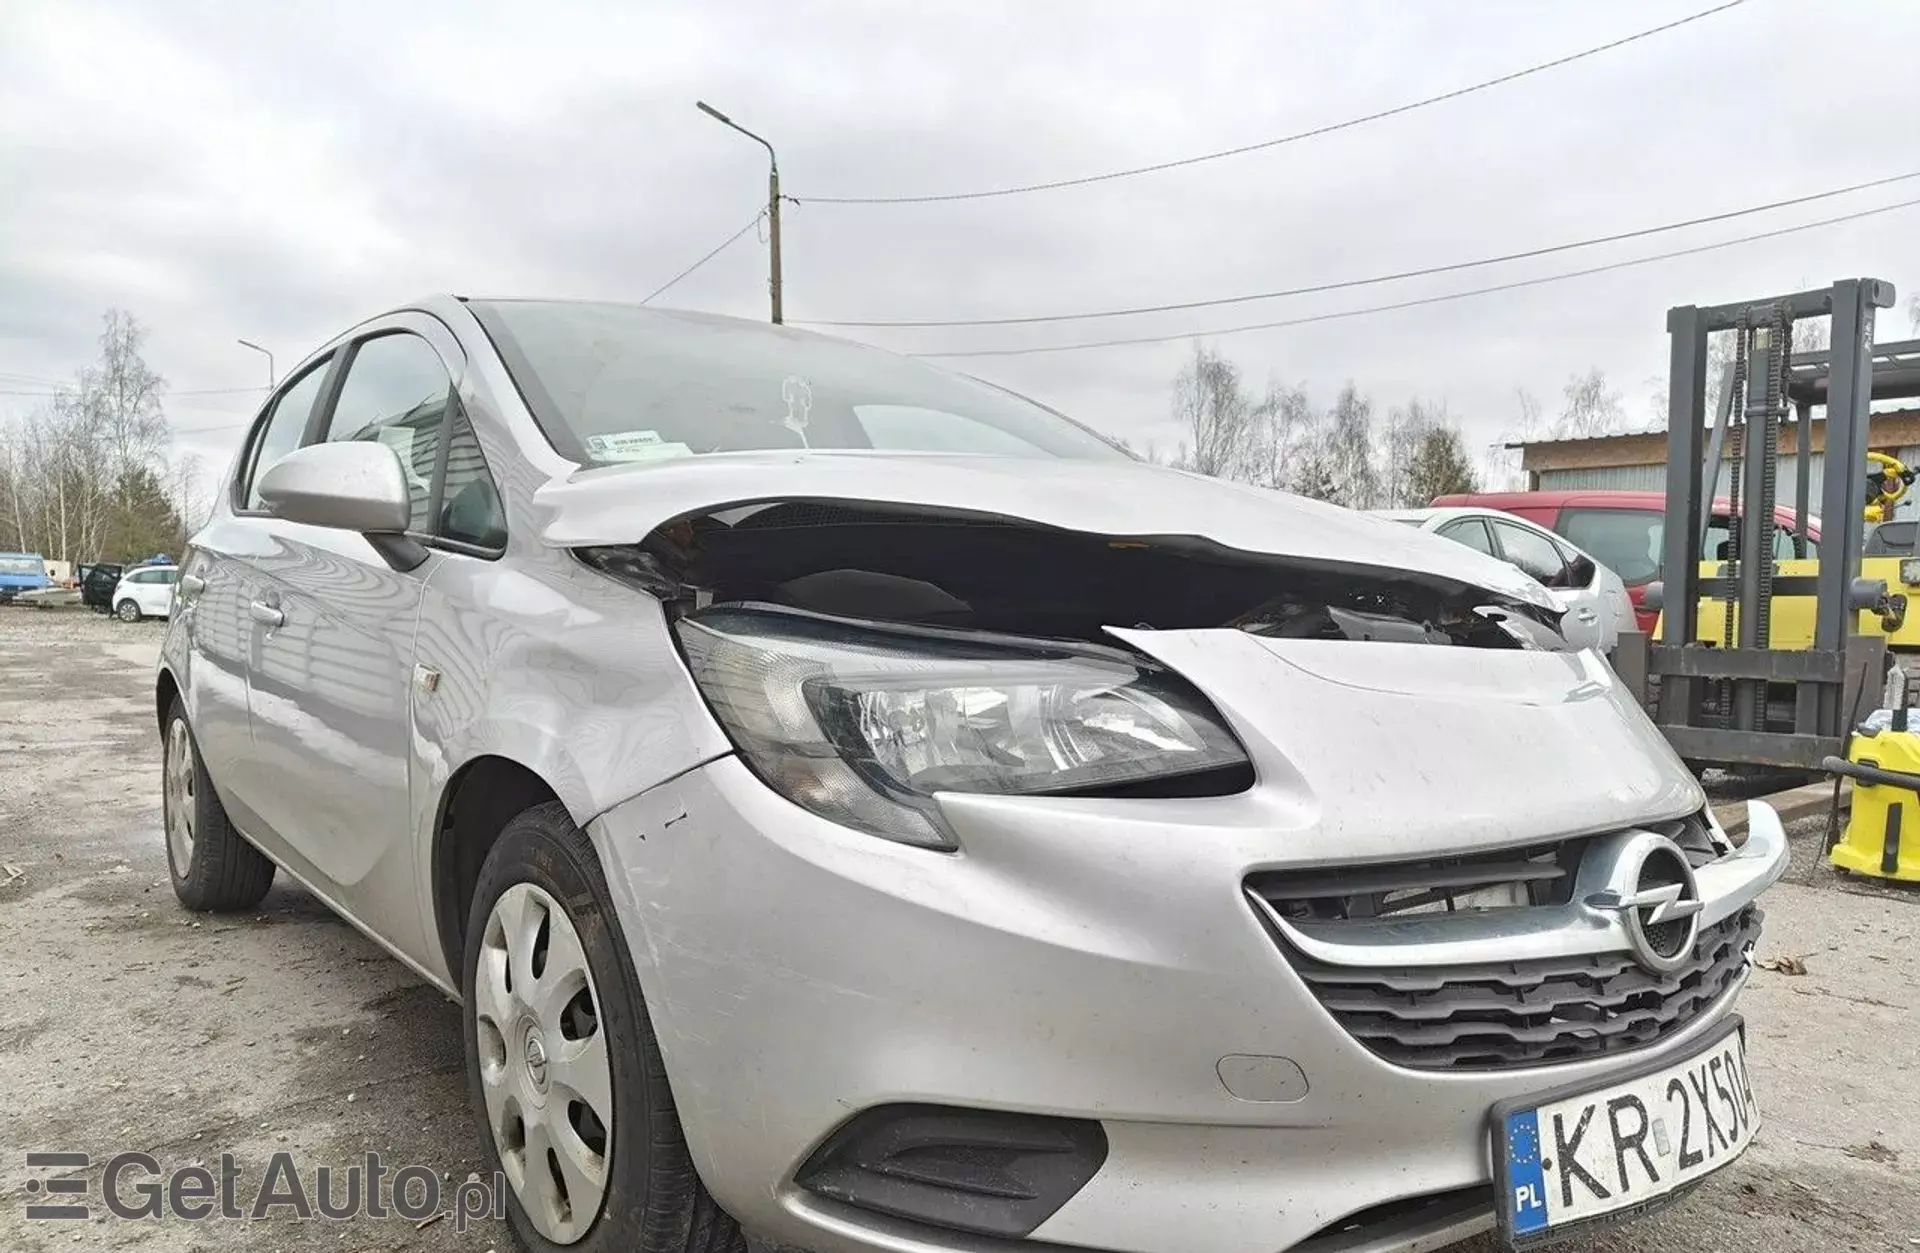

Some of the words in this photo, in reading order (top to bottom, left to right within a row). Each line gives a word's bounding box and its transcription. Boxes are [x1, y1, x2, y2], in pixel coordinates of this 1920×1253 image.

[1553, 1093, 1660, 1207] KR
[1667, 1040, 1757, 1170] 2X504
[1515, 1183, 1541, 1212] PL
